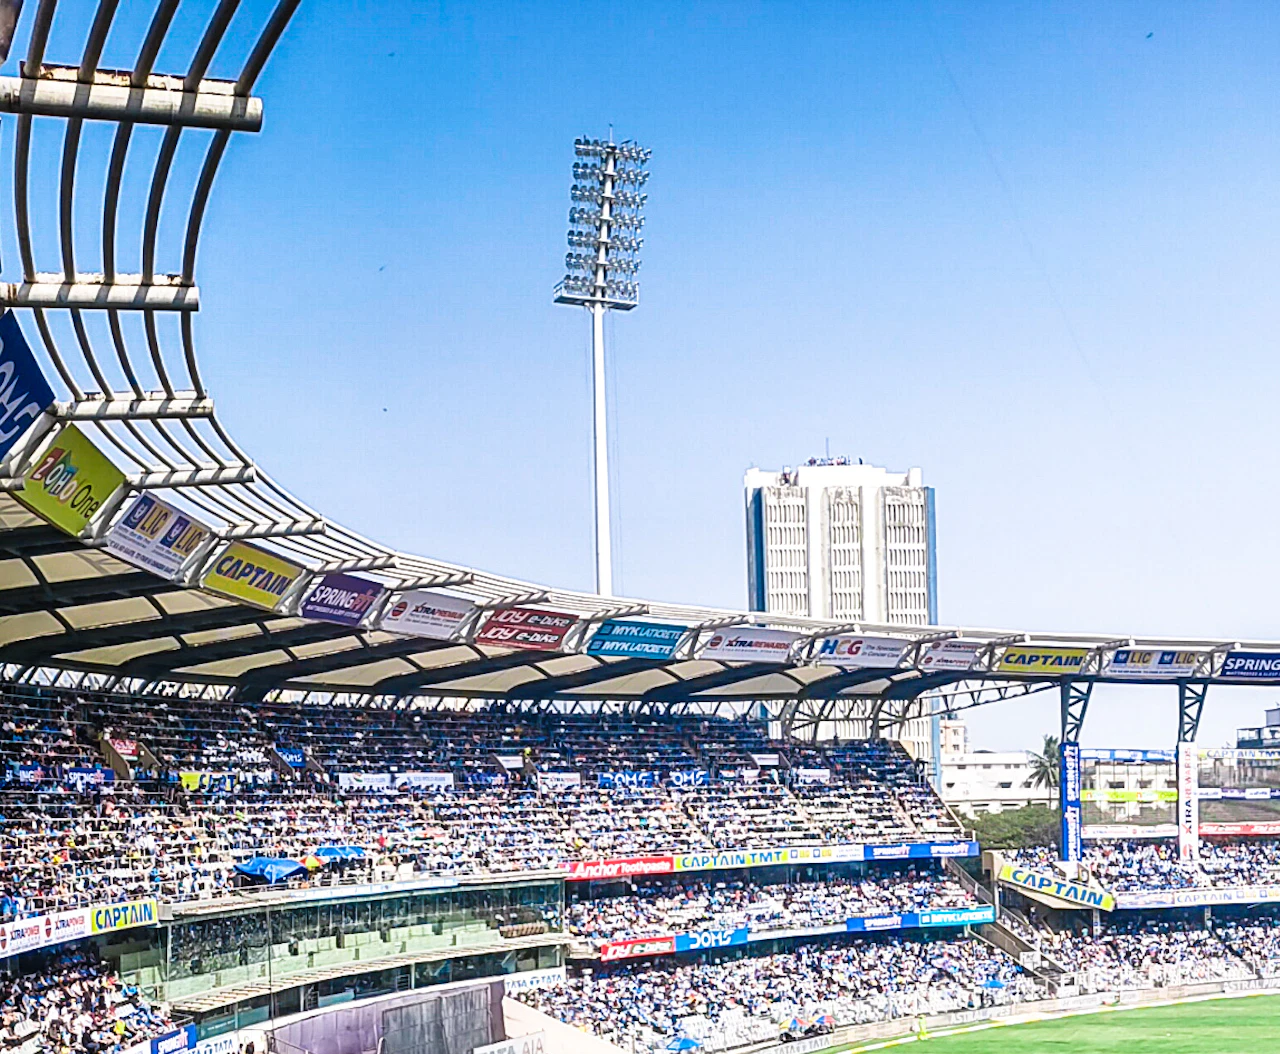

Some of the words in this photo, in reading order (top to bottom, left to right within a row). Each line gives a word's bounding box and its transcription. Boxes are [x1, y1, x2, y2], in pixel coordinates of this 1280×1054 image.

[33, 457, 77, 502] ZOHO
[71, 485, 100, 518] One
[139, 500, 167, 537] LIC
[215, 555, 292, 596] CAPTAIN
[310, 585, 376, 612] SPRINGFIT
[490, 609, 527, 623] JOY
[527, 614, 571, 628] e-bike
[481, 628, 518, 640] JOY
[517, 632, 559, 643] e-bike
[612, 625, 640, 637] MYK
[602, 641, 631, 651] MYK
[820, 639, 863, 655] HCG
[1003, 652, 1085, 666] CAPTAIN
[1132, 652, 1151, 664] LIC
[1175, 651, 1195, 664] LIC
[1206, 749, 1256, 759] CAPTAIN
[1184, 747, 1193, 835] XTRAREWARDS
[682, 852, 746, 868] CAPTAIN
[747, 851, 783, 863] TMT
[575, 859, 620, 879] Anchor
[1011, 869, 1105, 906] CAPTAIN
[1177, 890, 1233, 903] CAPTAIN
[95, 901, 153, 930] CAPTAIN
[689, 929, 736, 949] DOMS
[213, 1038, 234, 1054] TATA
